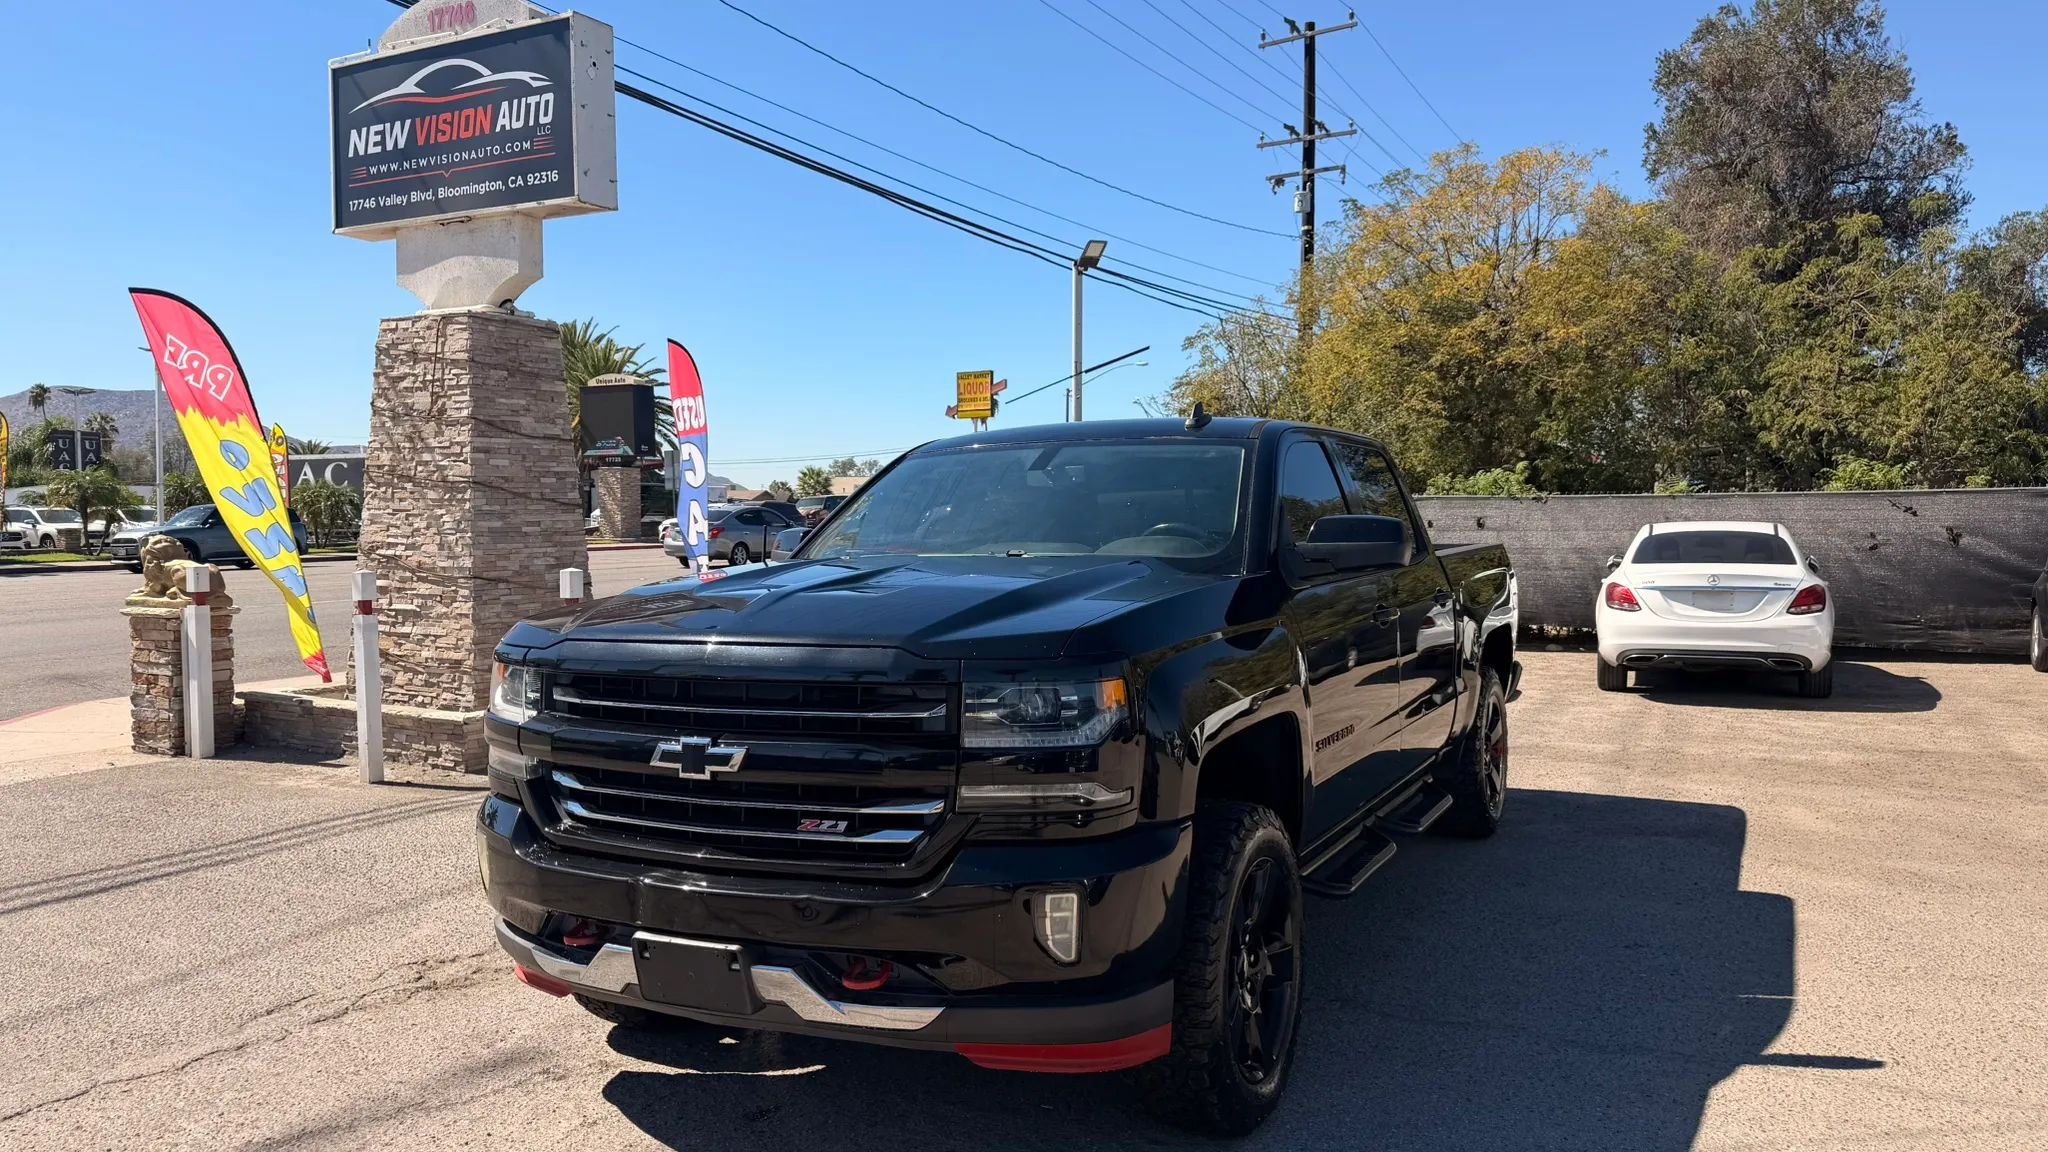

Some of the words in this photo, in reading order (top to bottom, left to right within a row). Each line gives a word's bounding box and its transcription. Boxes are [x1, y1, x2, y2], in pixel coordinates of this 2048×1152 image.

[348, 119, 412, 158] NEW
[415, 105, 493, 146] VISION
[495, 93, 555, 132] AUTO
[536, 125, 552, 135] LLC
[369, 140, 531, 175] WWW.NEWVISIONAUTO.COM
[349, 197, 376, 212] 17746
[378, 194, 408, 207] Valley
[410, 188, 435, 203] Blvd,
[438, 180, 506, 199] Bloomington,
[508, 175, 524, 188] CA
[527, 170, 559, 186] 92316
[1315, 723, 1355, 752] SILVERADO
[796, 818, 848, 833] Z71
